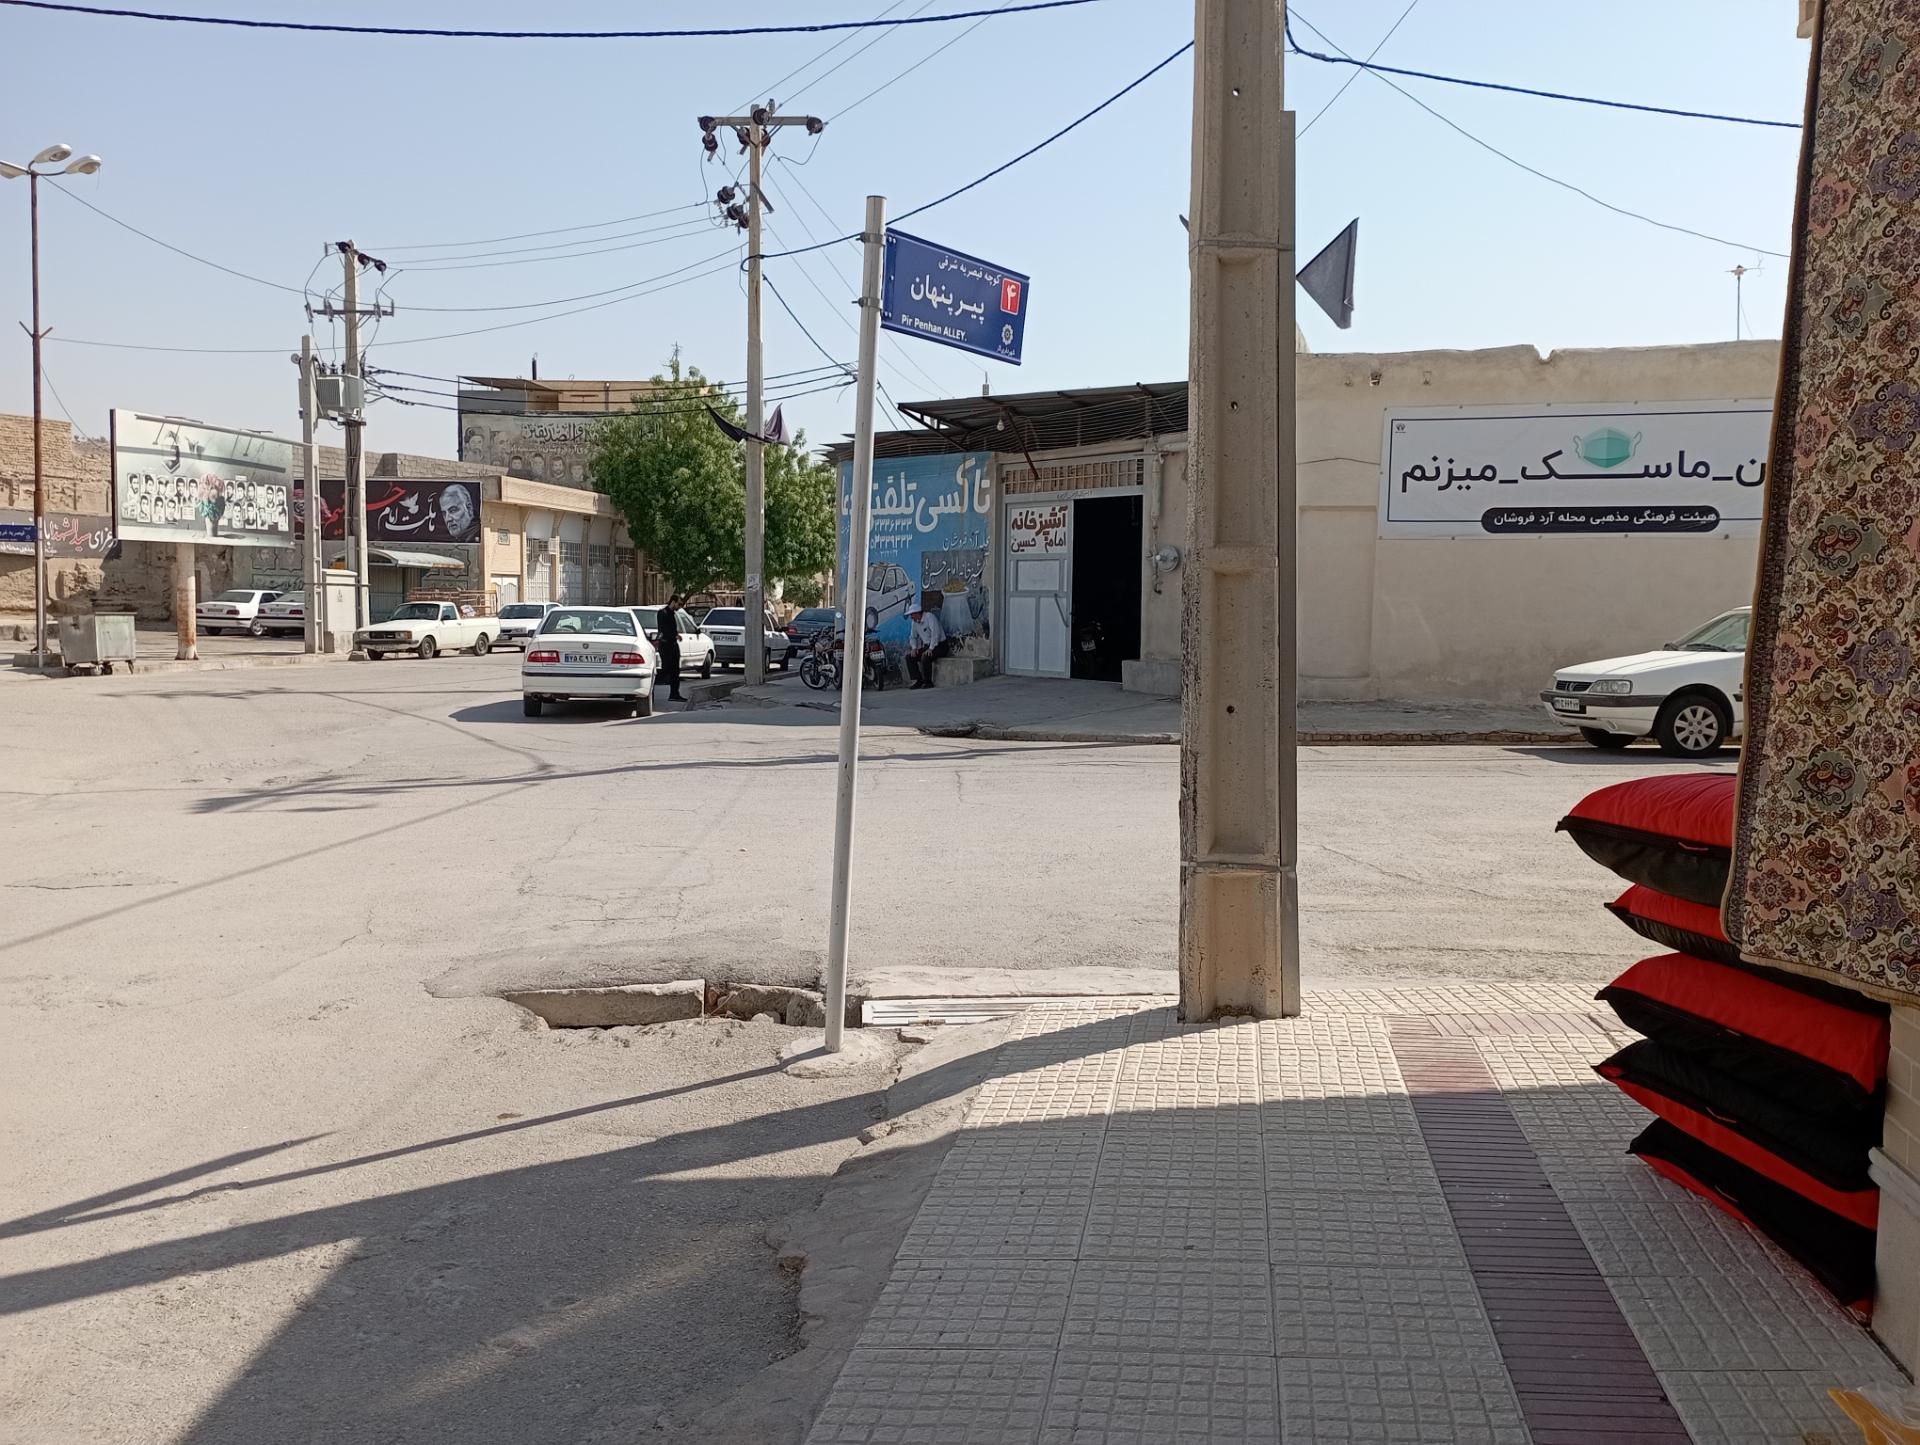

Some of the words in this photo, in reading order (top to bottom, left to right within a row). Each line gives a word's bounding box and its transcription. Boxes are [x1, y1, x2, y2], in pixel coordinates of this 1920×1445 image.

[938, 255, 958, 271] شرقی
[960, 263, 983, 281] قیصریه
[984, 274, 1001, 287] کوچه
[910, 274, 953, 316] پنهان
[1006, 283, 1017, 310] ۴
[954, 299, 985, 325] پیر
[901, 313, 912, 325] Pir
[914, 318, 942, 335] Penhan
[915, 457, 990, 533] تاکسی
[377, 505, 398, 533] امام
[1011, 505, 1068, 537] آشپزخانه
[1494, 512, 1535, 526] فروشان
[1539, 511, 1555, 525] آرد
[1558, 512, 1586, 523] محله
[1589, 511, 1630, 525] مذهبی
[1633, 509, 1676, 525] فرهنگی
[1680, 512, 1717, 524] هیئت
[1011, 538, 1037, 553] حسین
[1044, 530, 1066, 553] امام
